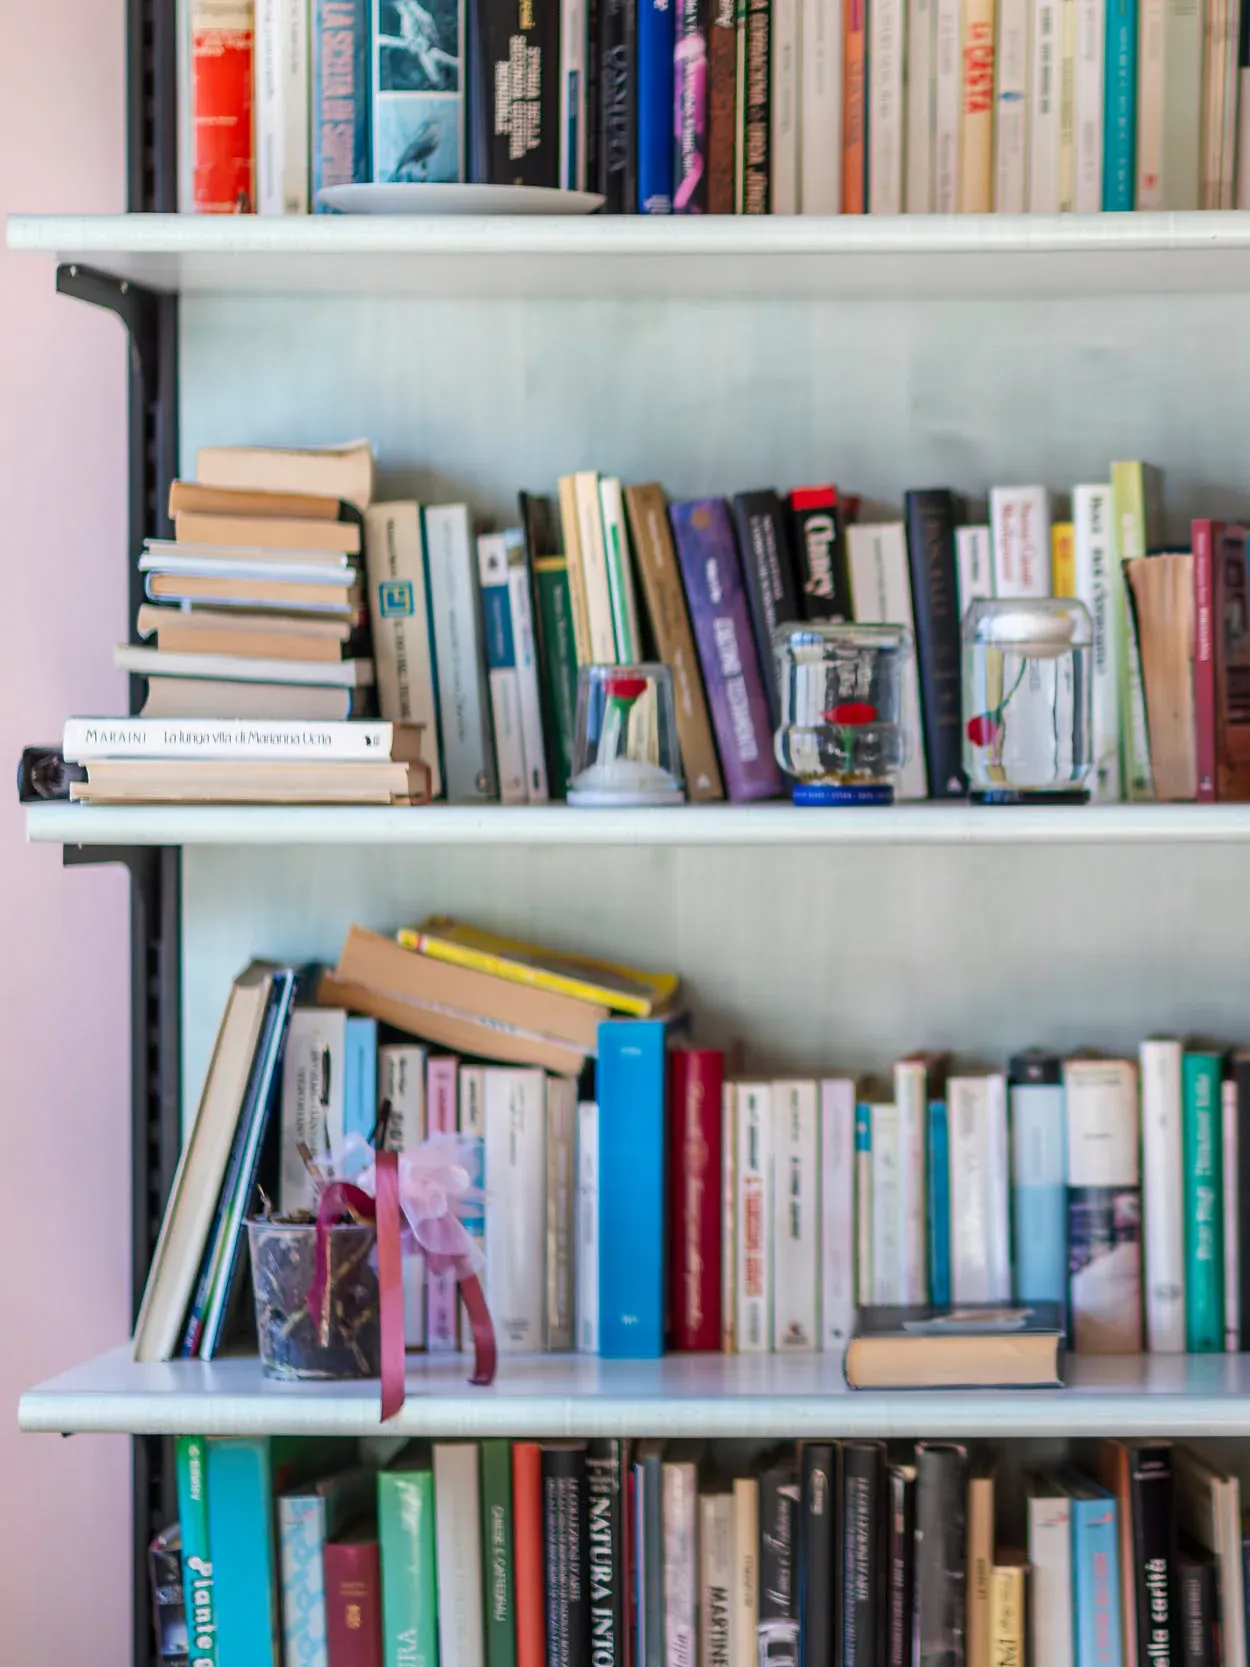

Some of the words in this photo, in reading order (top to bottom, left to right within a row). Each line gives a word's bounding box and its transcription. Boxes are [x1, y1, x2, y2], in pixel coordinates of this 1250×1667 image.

[804, 515, 836, 599] Clancy
[84, 728, 148, 744] MARAINI
[589, 1496, 614, 1602] NATURA
[1145, 1558, 1169, 1623] carità
